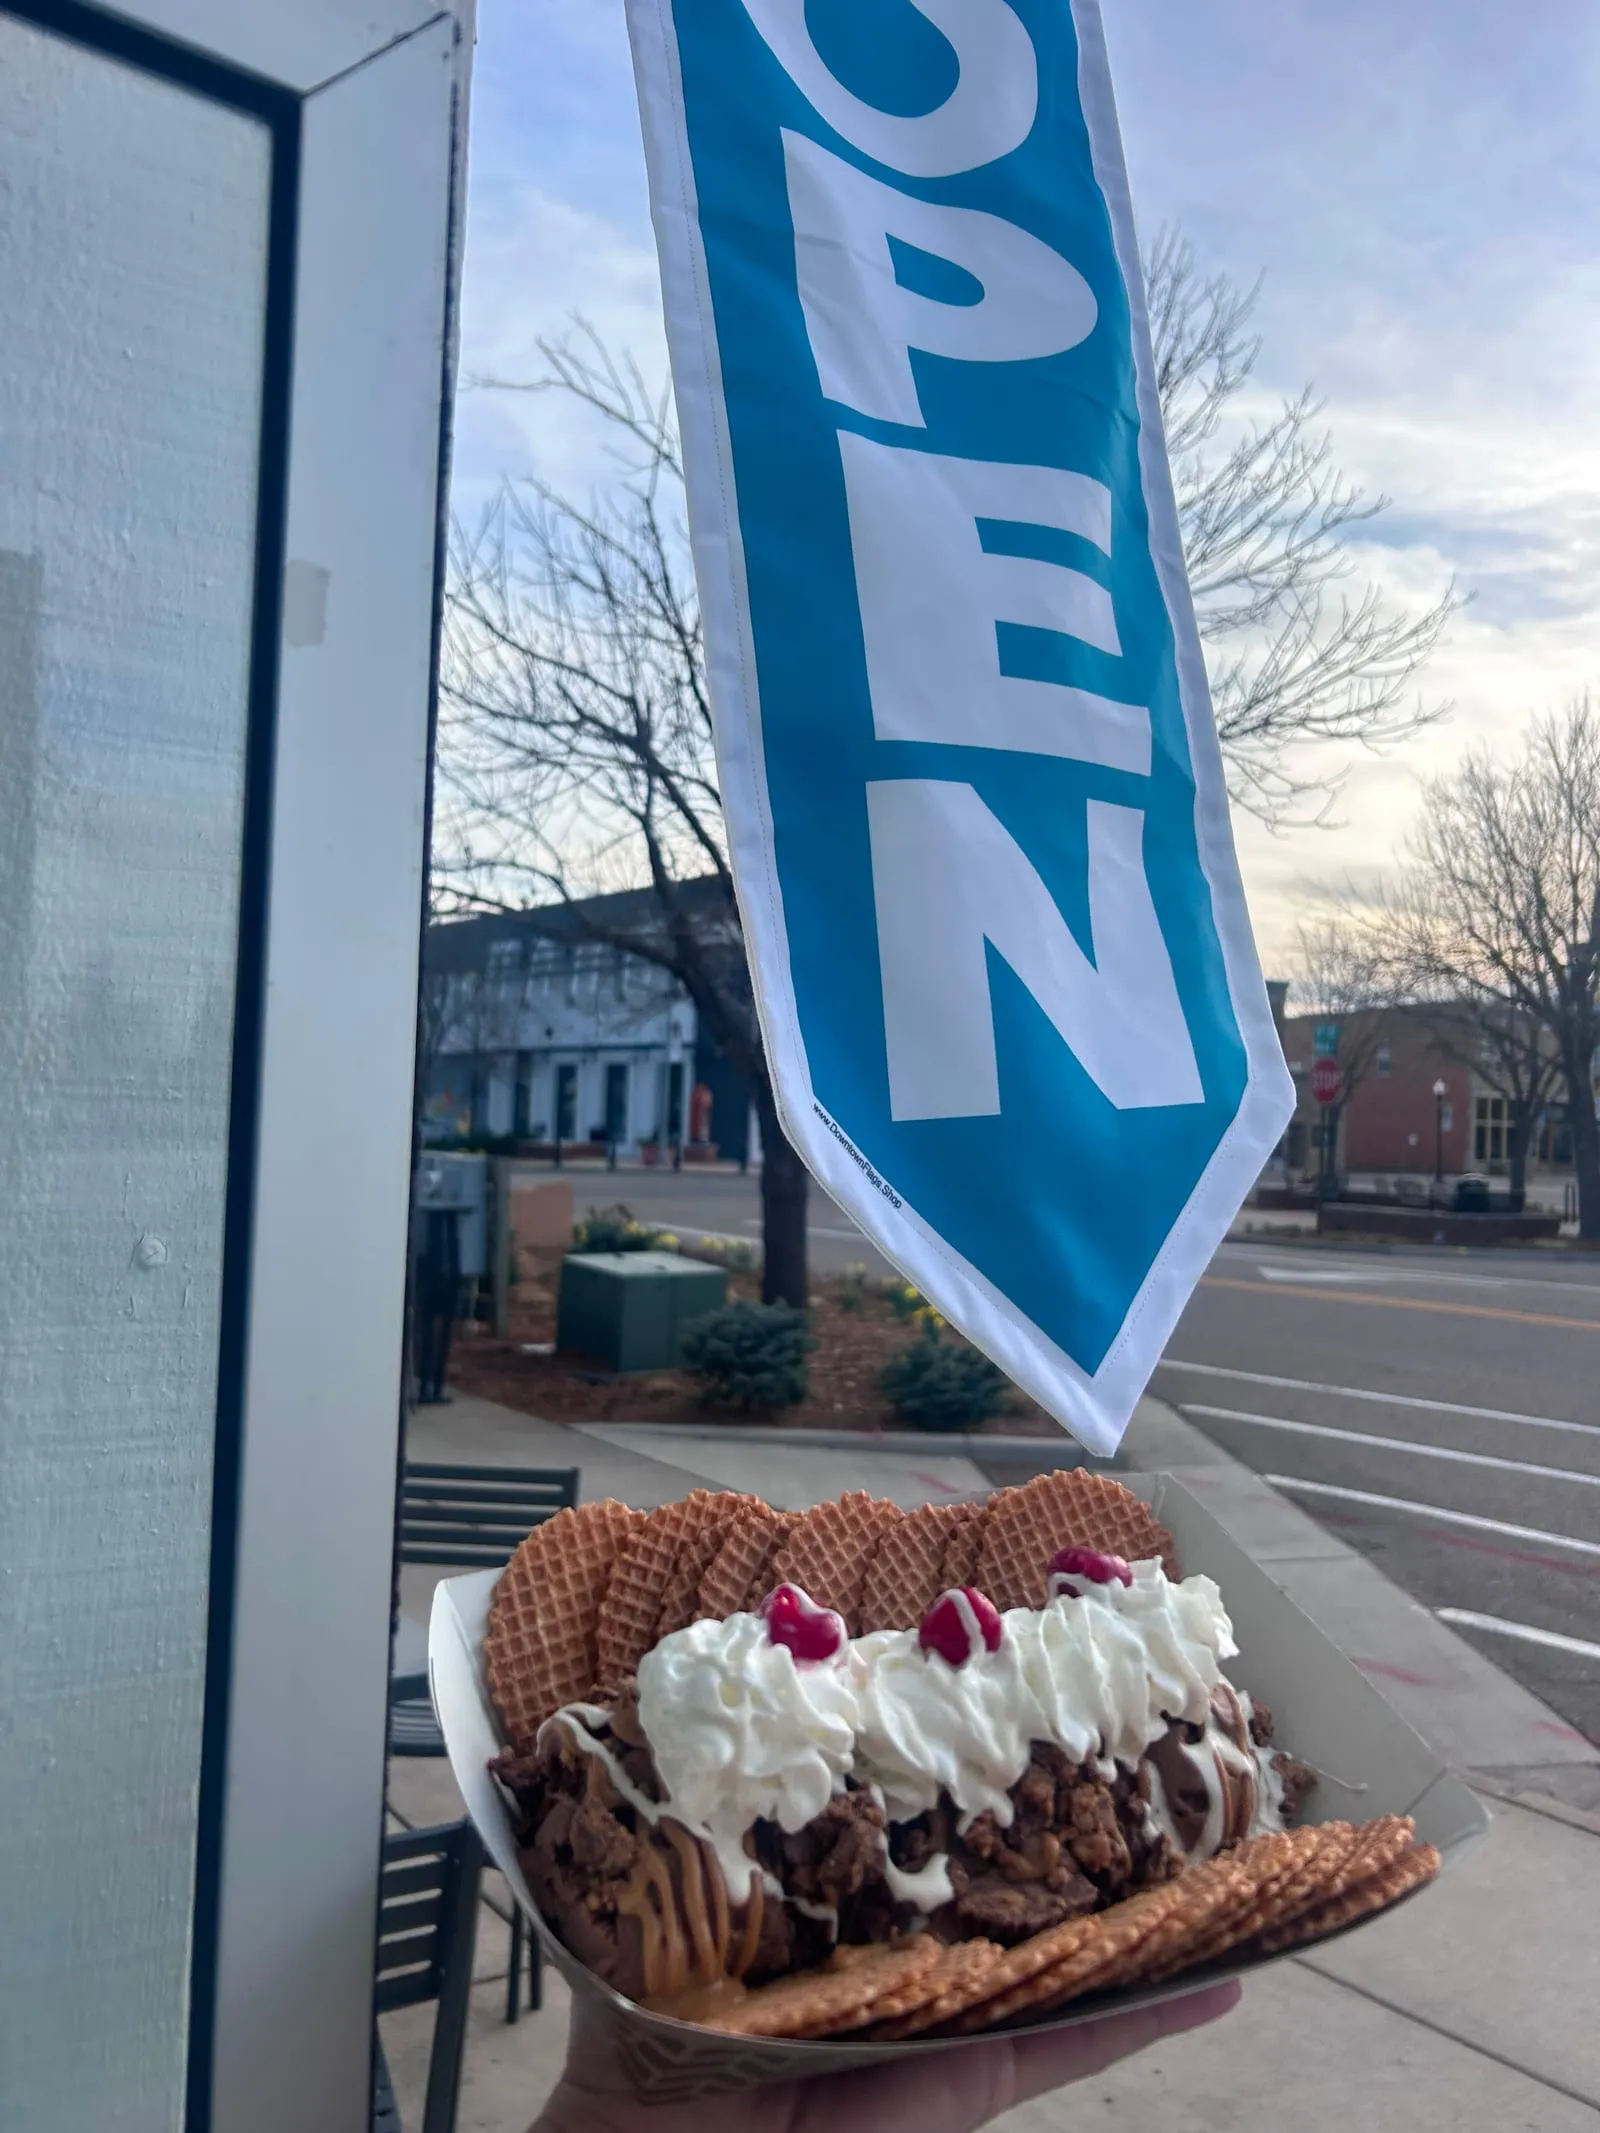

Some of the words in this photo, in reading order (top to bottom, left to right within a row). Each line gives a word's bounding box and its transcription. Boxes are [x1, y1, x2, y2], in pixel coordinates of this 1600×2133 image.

[741, 0, 1205, 1122] OPEN
[1312, 1070, 1341, 1089] STOP
[813, 1103, 903, 1209] www.DowntownFlags.Shop
